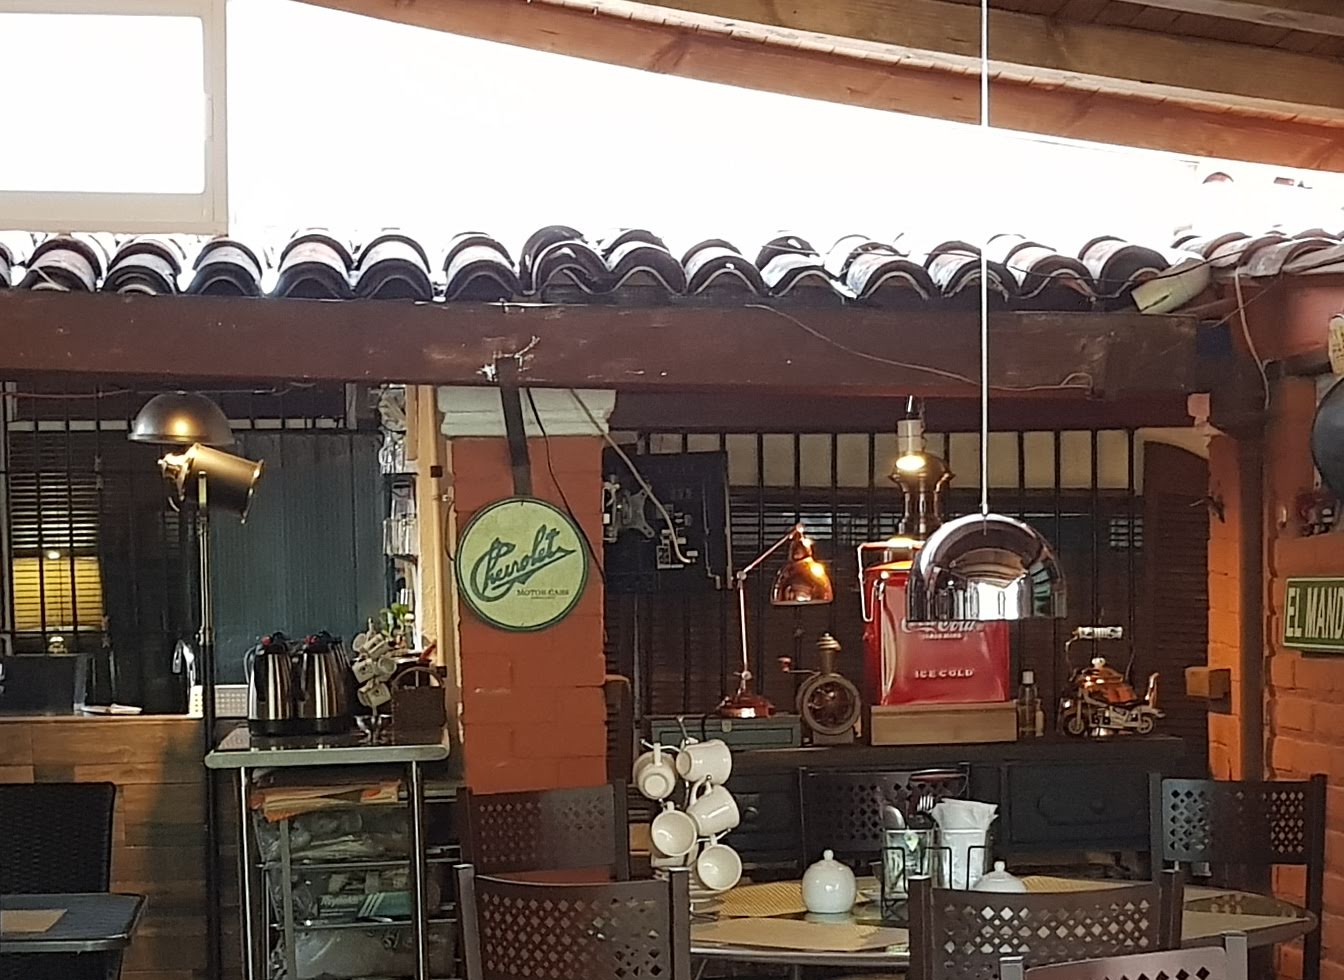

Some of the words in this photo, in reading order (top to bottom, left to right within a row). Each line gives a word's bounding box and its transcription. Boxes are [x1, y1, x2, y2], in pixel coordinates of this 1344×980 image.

[1285, 587, 1302, 637] EL
[914, 670, 937, 679] ICE
[938, 668, 974, 678] COLD
